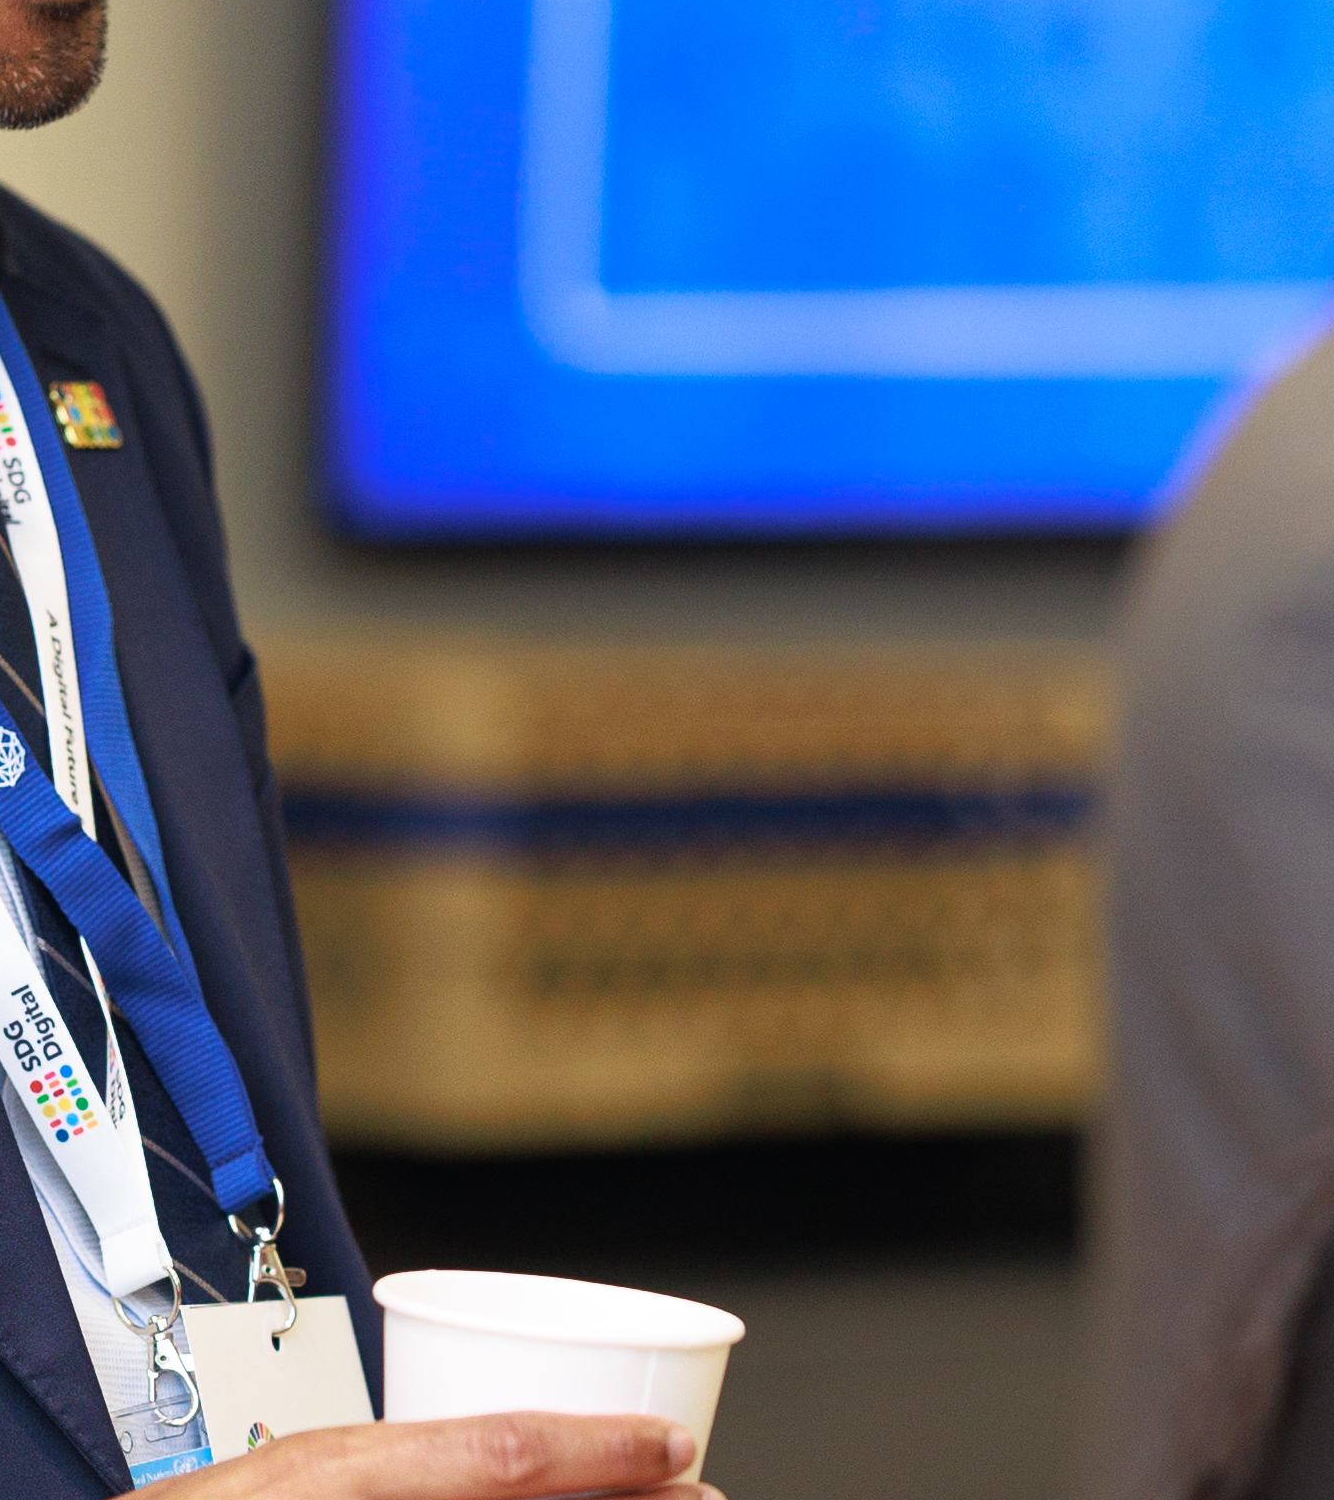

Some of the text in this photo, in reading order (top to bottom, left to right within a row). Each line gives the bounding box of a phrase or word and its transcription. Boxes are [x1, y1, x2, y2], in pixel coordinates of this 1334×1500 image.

[3, 457, 32, 505] SDG
[3, 1019, 42, 1073] SDG
[10, 983, 64, 1062] Digital
